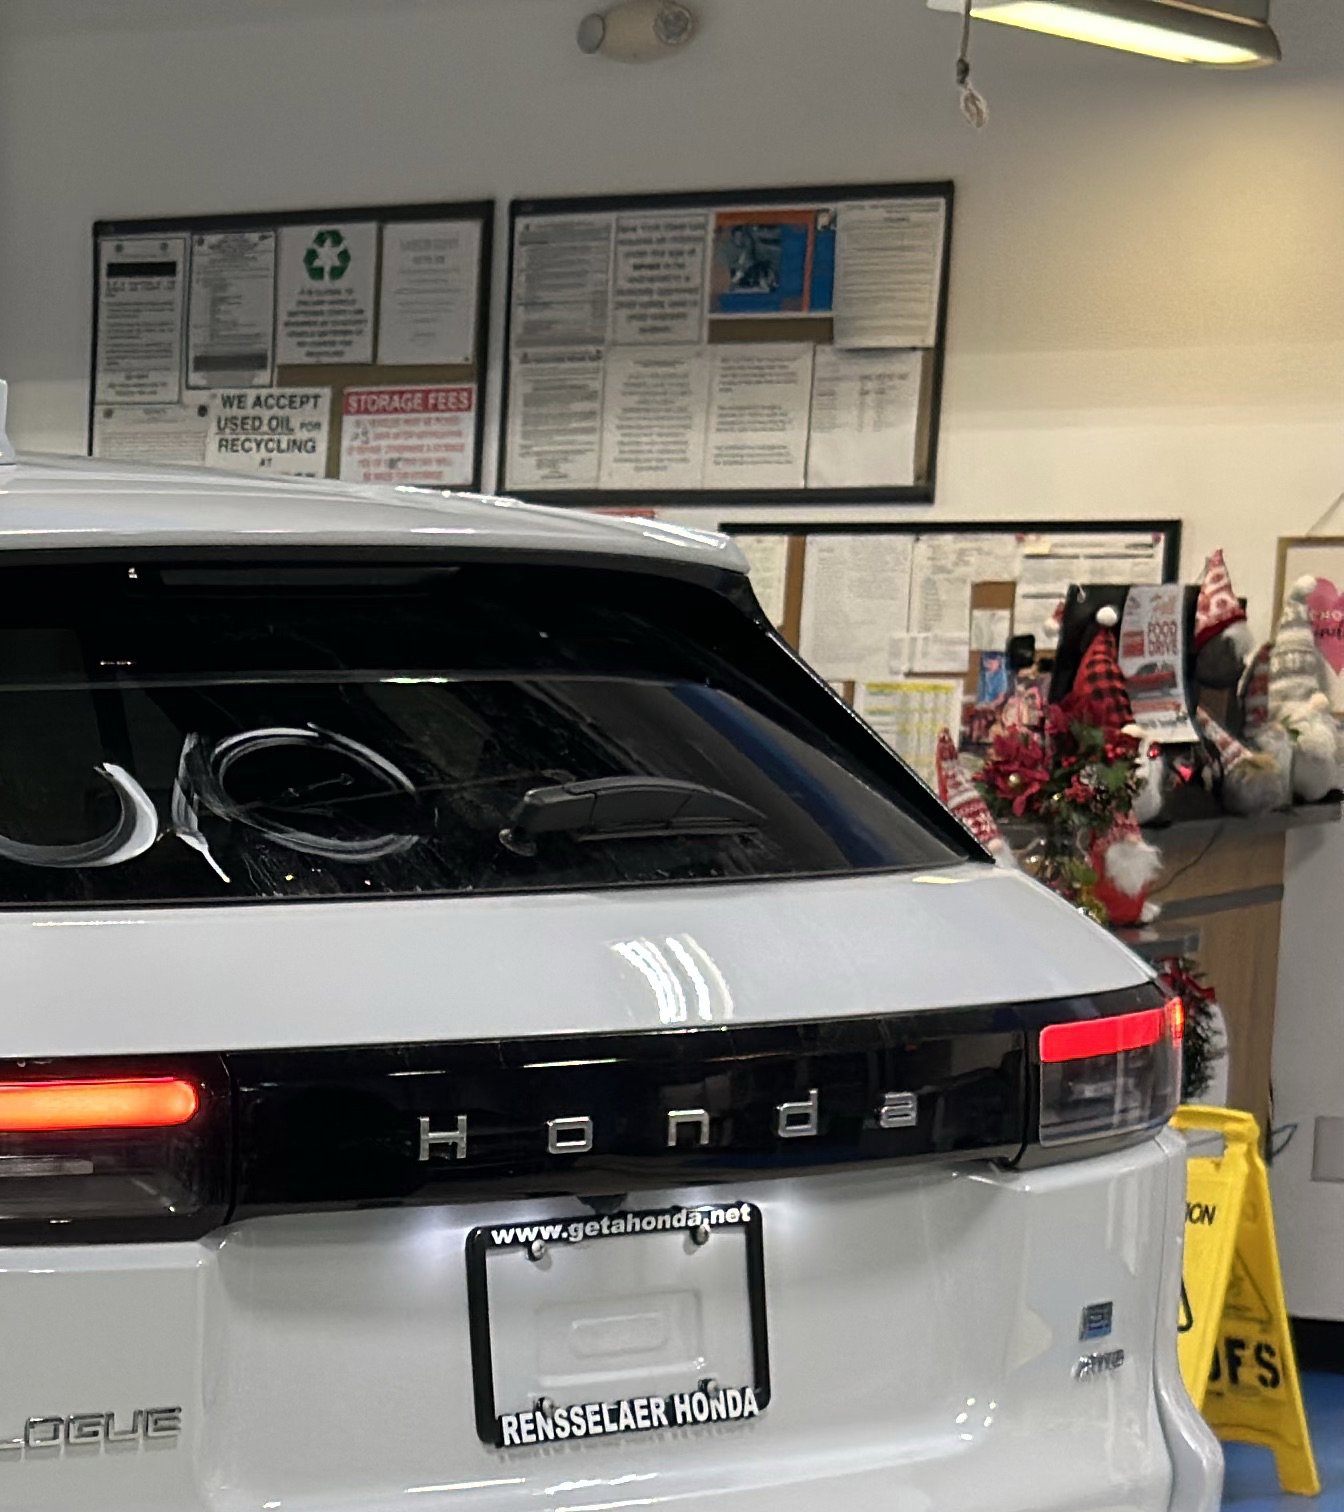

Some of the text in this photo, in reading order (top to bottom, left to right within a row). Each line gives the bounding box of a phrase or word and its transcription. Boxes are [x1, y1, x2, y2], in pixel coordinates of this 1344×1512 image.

[221, 394, 323, 410] WE ACCEPT
[347, 391, 470, 413] STORAGE FEES
[216, 416, 262, 432] USED
[267, 416, 295, 432] OIL
[218, 438, 317, 454] RECYCLING
[1148, 621, 1178, 638] FOOD
[1148, 638, 1178, 656] DRIVE
[419, 1088, 918, 1161] Honda
[490, 1203, 752, 1245] www.getahonda.net
[502, 1387, 760, 1446] RENSSELAER HONDA
